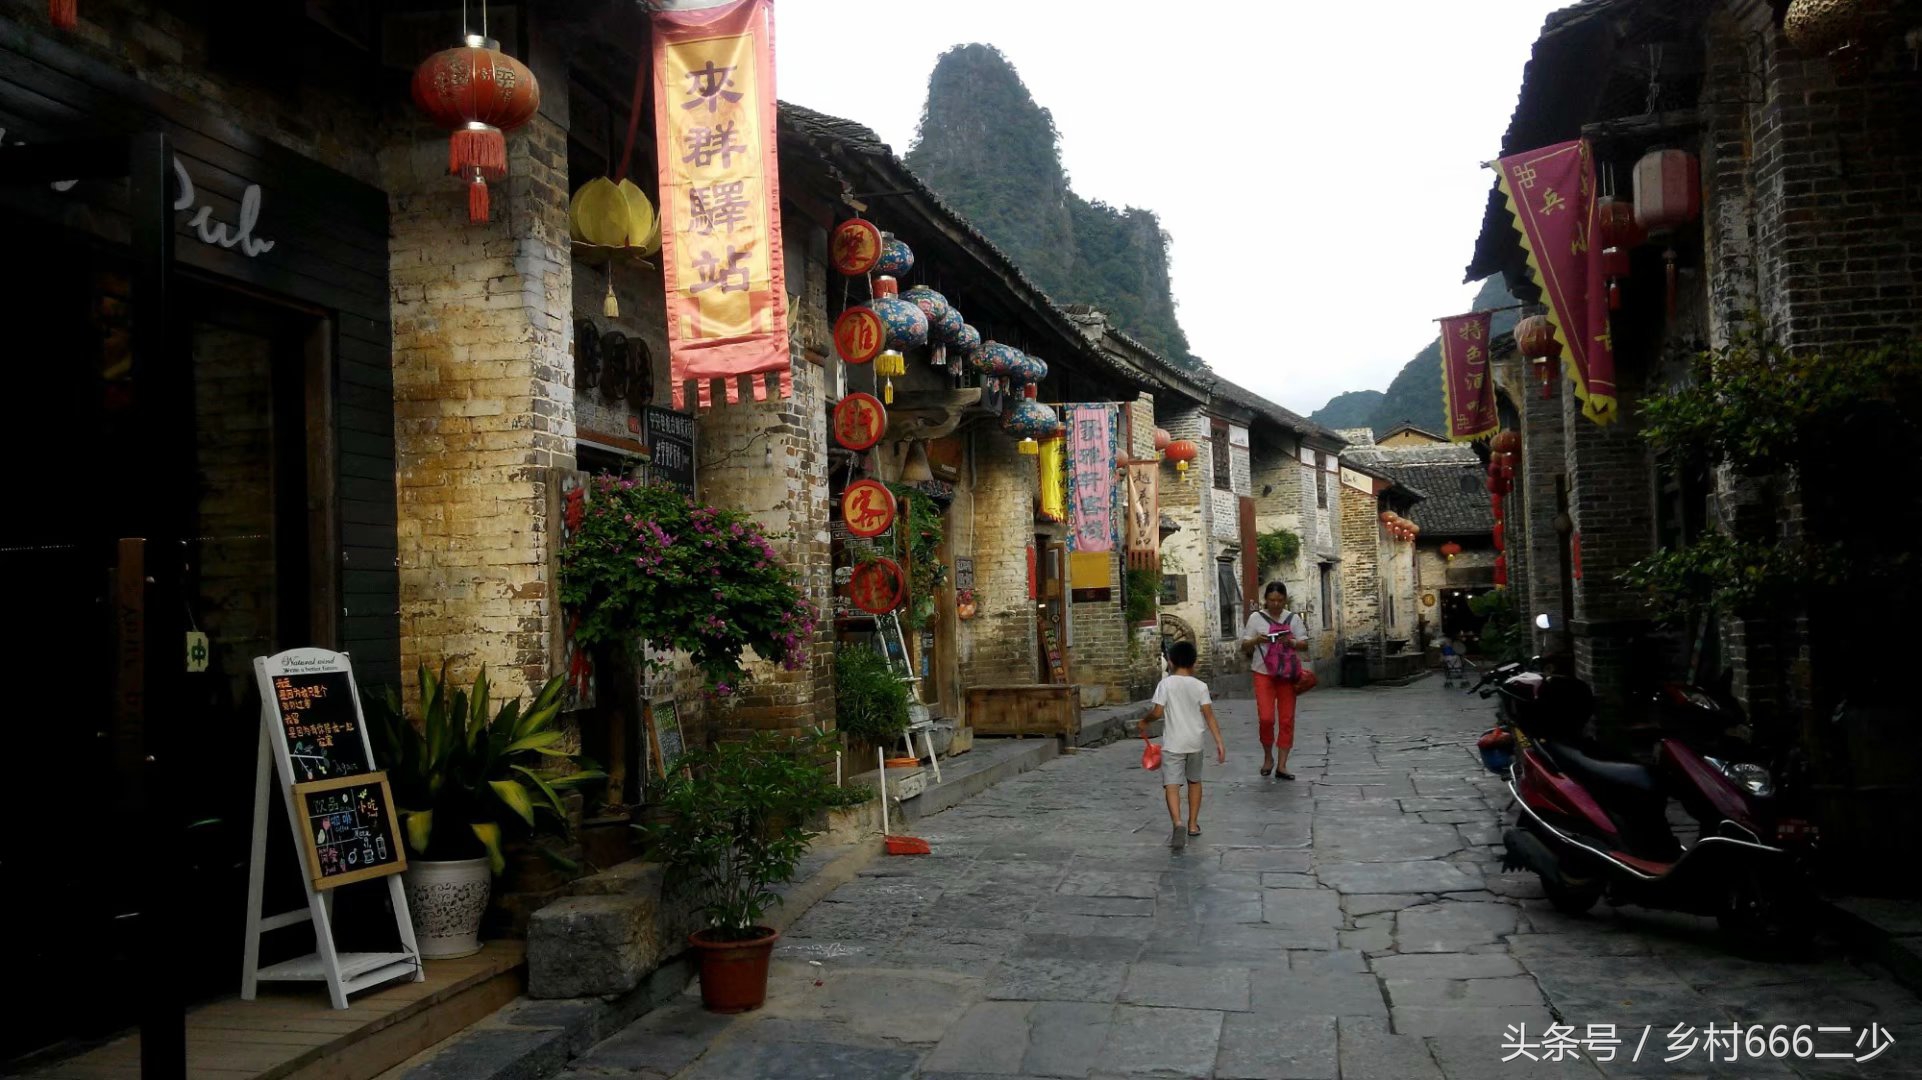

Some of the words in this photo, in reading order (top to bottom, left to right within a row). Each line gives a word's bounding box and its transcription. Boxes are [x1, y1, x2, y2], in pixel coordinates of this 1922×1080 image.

[680, 60, 751, 295] 來群驛站
[357, 798, 379, 813] 小吃
